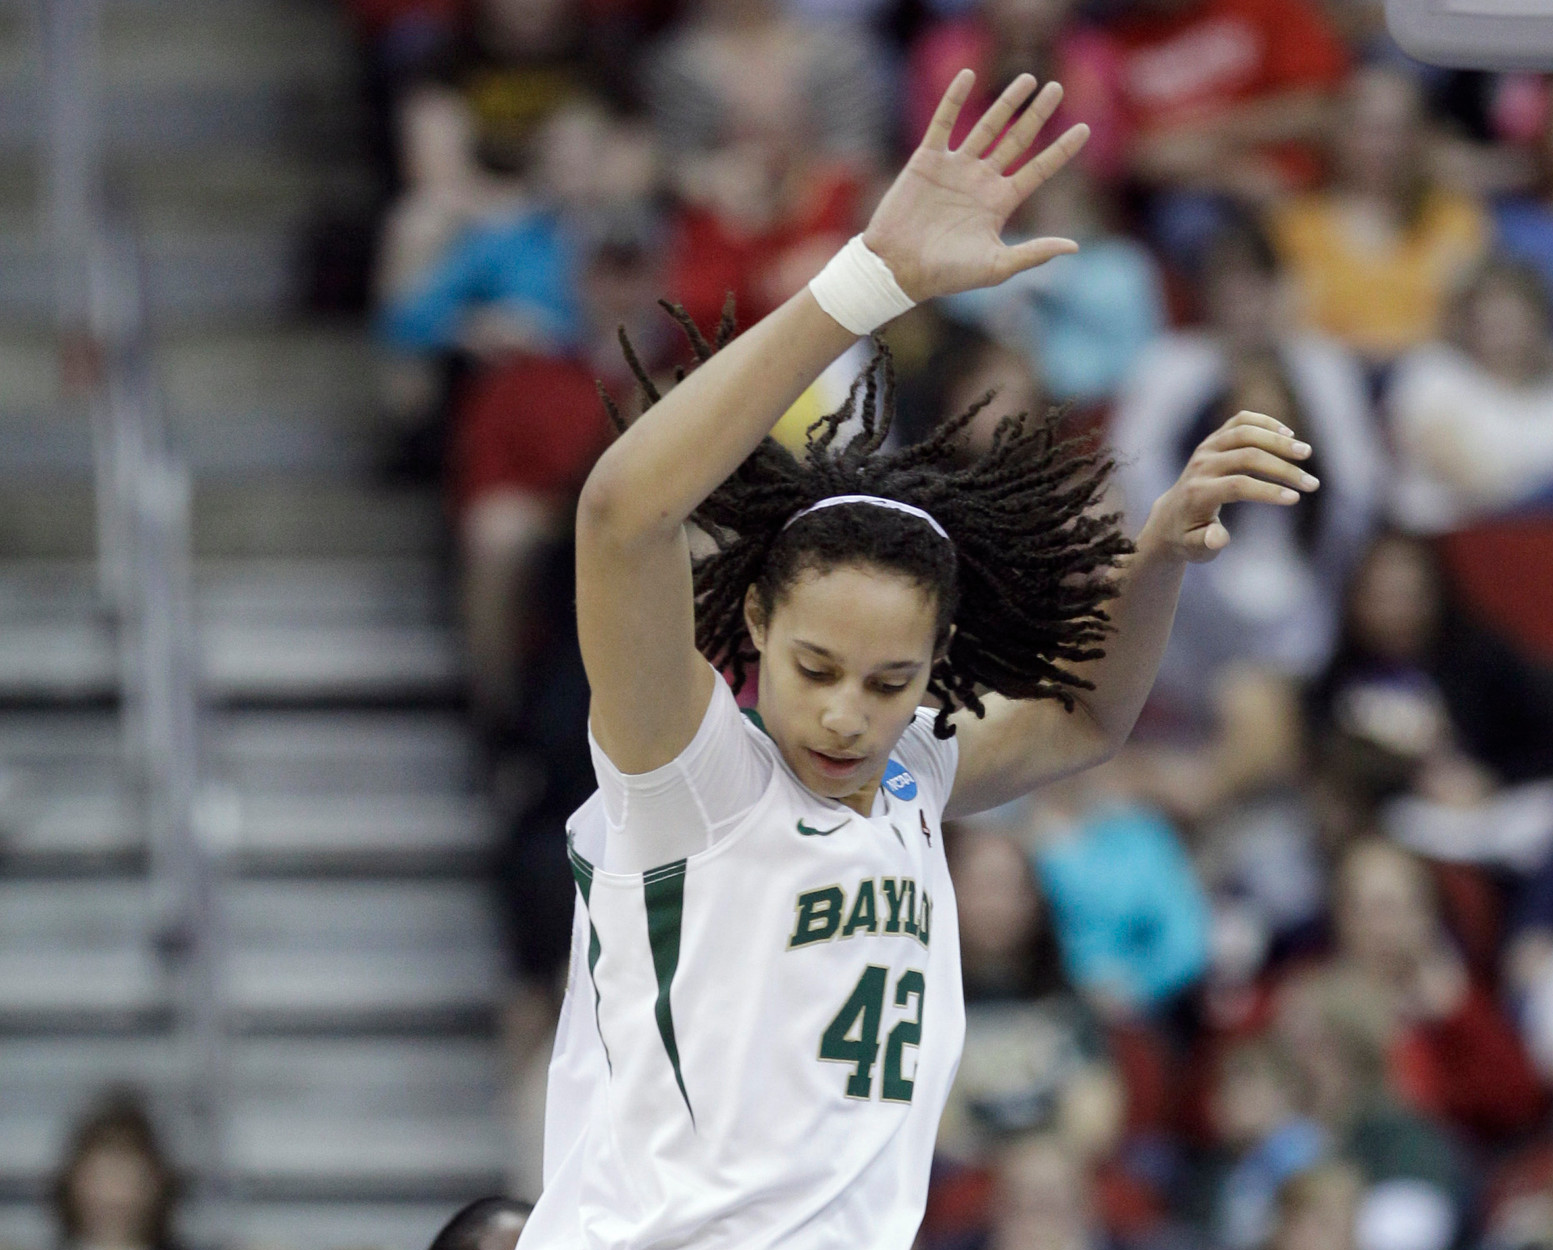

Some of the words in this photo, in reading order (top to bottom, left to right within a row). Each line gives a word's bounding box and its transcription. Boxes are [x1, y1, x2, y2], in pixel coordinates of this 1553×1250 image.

[886, 772, 915, 792] NCAA
[786, 876, 933, 951] BAYLO
[816, 963, 926, 1104] 42
